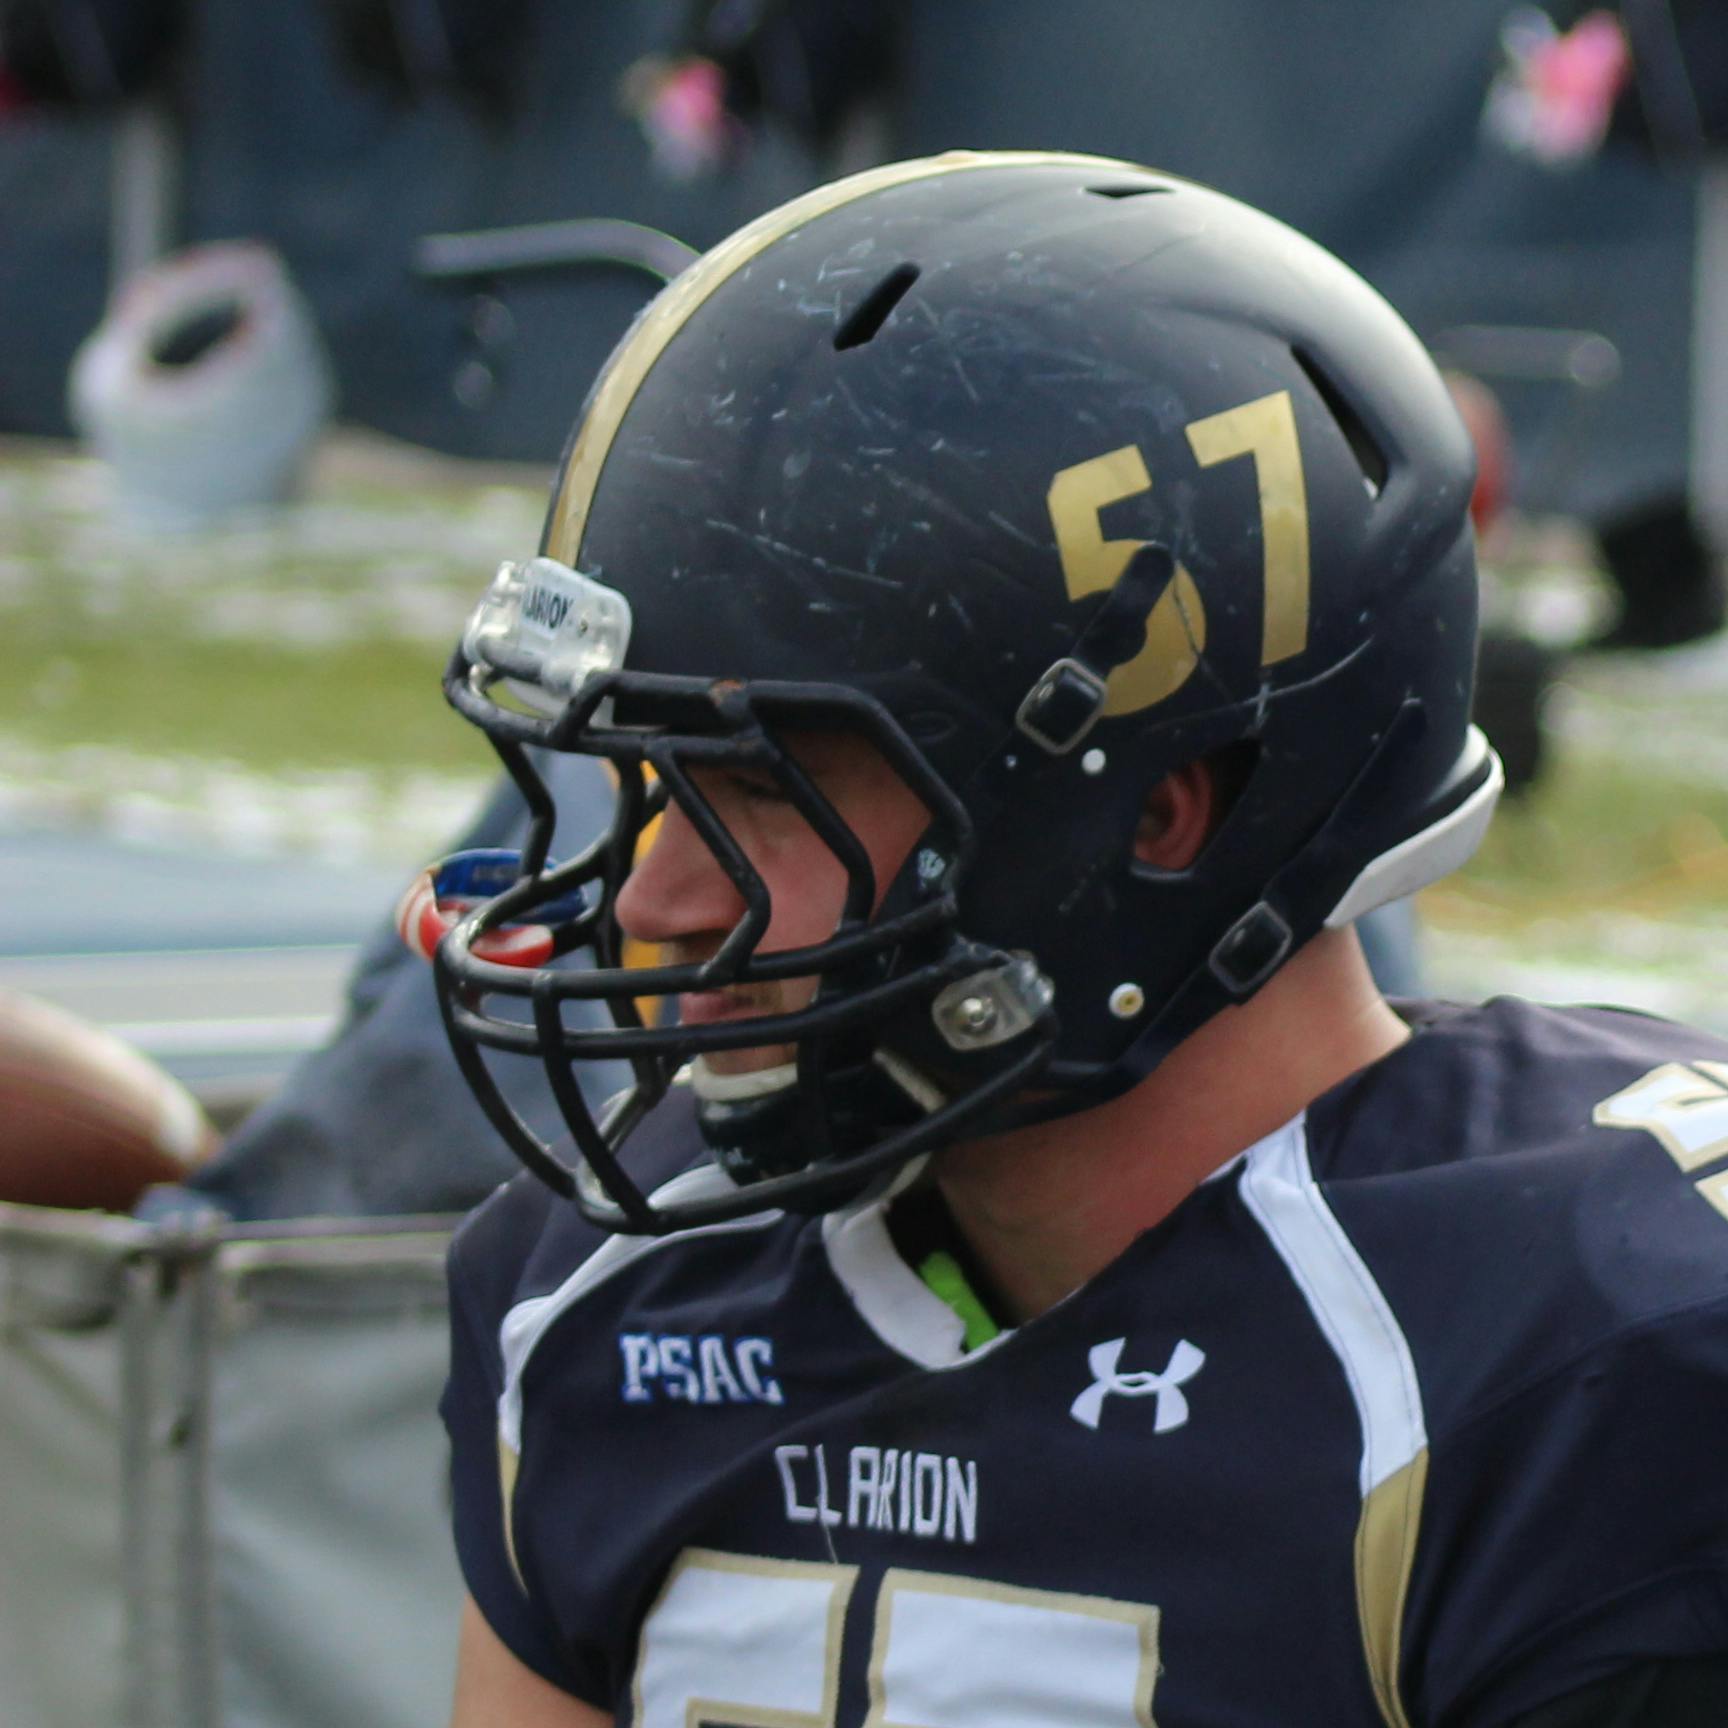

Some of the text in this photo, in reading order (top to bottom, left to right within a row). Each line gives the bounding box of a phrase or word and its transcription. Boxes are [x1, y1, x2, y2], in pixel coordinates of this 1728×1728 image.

[1047, 390, 1309, 716] 57
[620, 1331, 782, 1403] PSAC
[775, 1445, 978, 1543] CLARION
